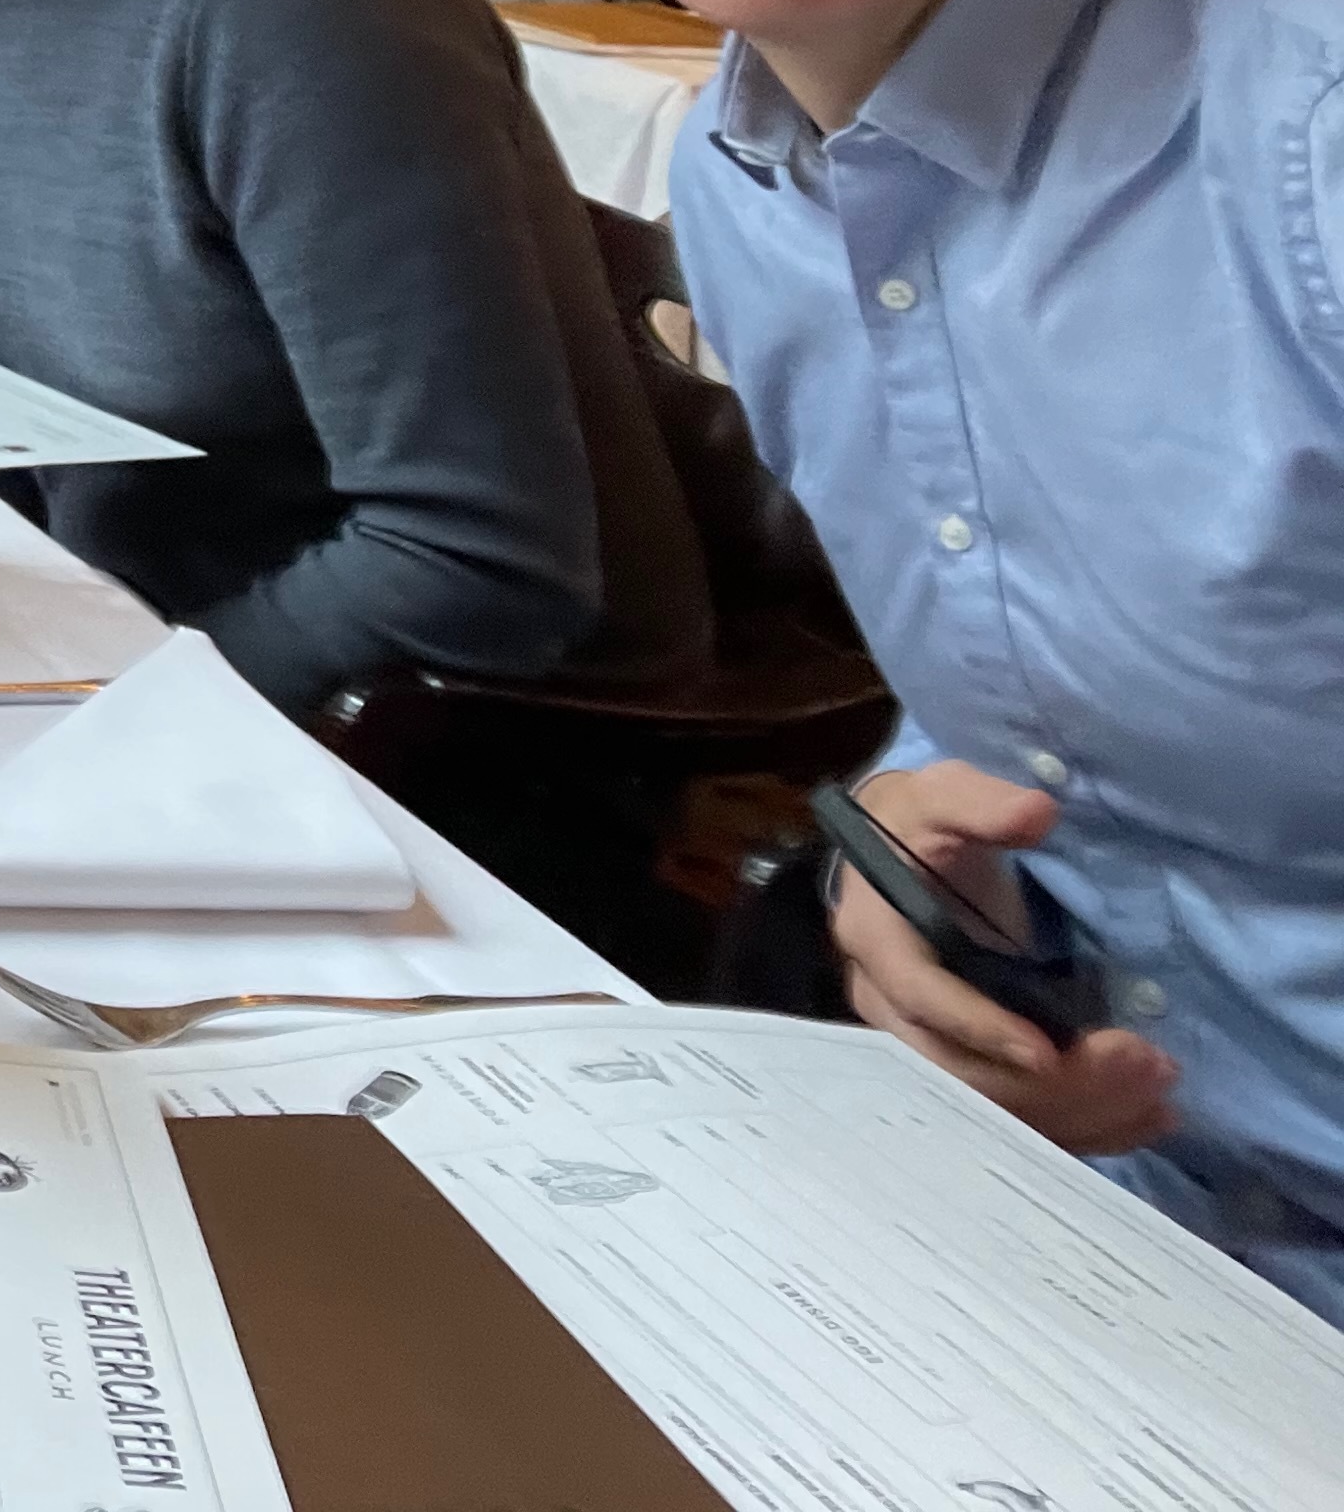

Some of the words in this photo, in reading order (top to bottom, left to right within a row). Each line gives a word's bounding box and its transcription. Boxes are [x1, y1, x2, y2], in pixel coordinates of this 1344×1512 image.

[774, 1282, 841, 1330] DISHES
[36, 1321, 73, 1400] LUNCH
[78, 1271, 180, 1487] THEATERCAFEEN
